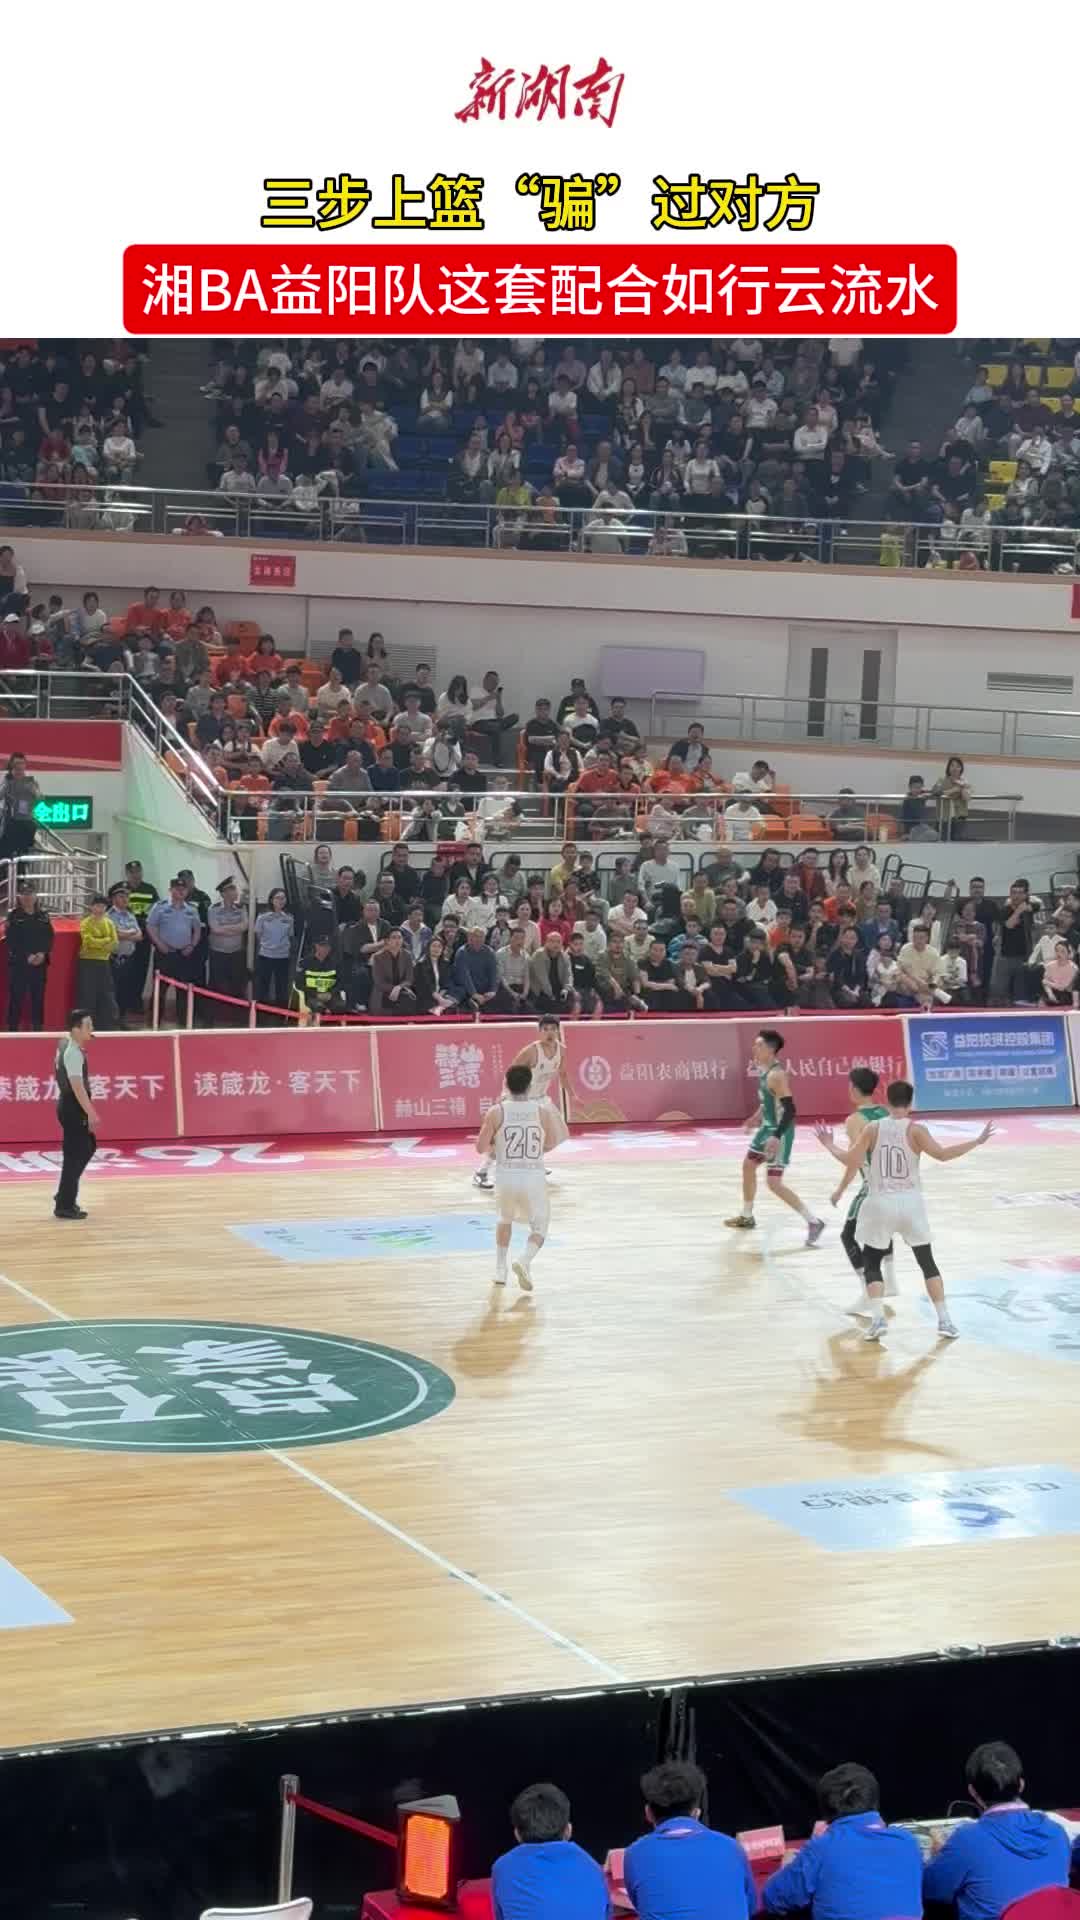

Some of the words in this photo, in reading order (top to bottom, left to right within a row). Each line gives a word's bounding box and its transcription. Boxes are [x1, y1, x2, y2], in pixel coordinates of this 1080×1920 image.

[620, 1059, 728, 1081] 益阳农商银行
[747, 1055, 904, 1078] 益人民自己的银行
[504, 1126, 541, 1160] 26
[880, 1144, 910, 1180] 10
